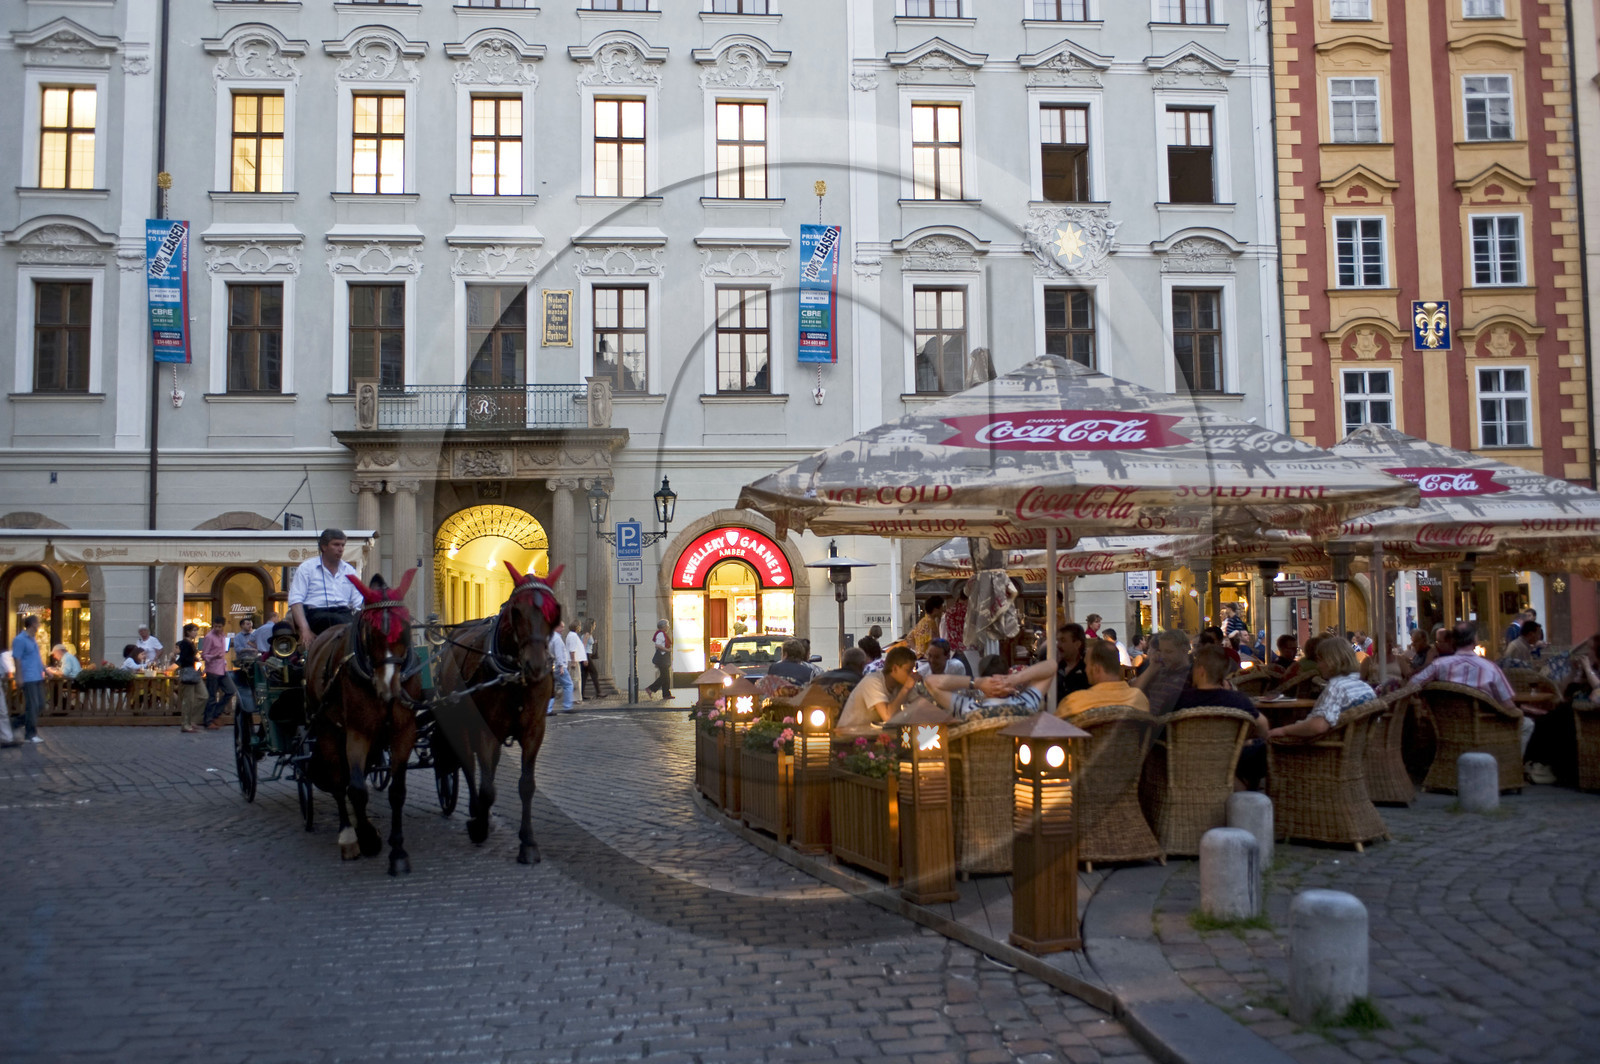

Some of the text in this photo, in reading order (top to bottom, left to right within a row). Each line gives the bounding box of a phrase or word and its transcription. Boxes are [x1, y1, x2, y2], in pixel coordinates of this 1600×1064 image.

[150, 254, 170, 276] 100%
[160, 224, 186, 256] LEASED
[805, 258, 822, 279] 100%
[814, 228, 838, 259] LEASED
[975, 419, 1149, 443] Coca-Cola
[828, 485, 953, 506] ICE COLD
[1016, 485, 1140, 521] Coca-Cola
[1176, 485, 1330, 499] SOLD HERE
[1416, 522, 1496, 547] Coca-Cola
[1520, 518, 1570, 531] SOLD
[621, 527, 636, 547] P
[682, 536, 782, 586] JEWELLERY GARNET
[1056, 552, 1115, 572] Coca-Cola
[230, 603, 257, 613] Moser
